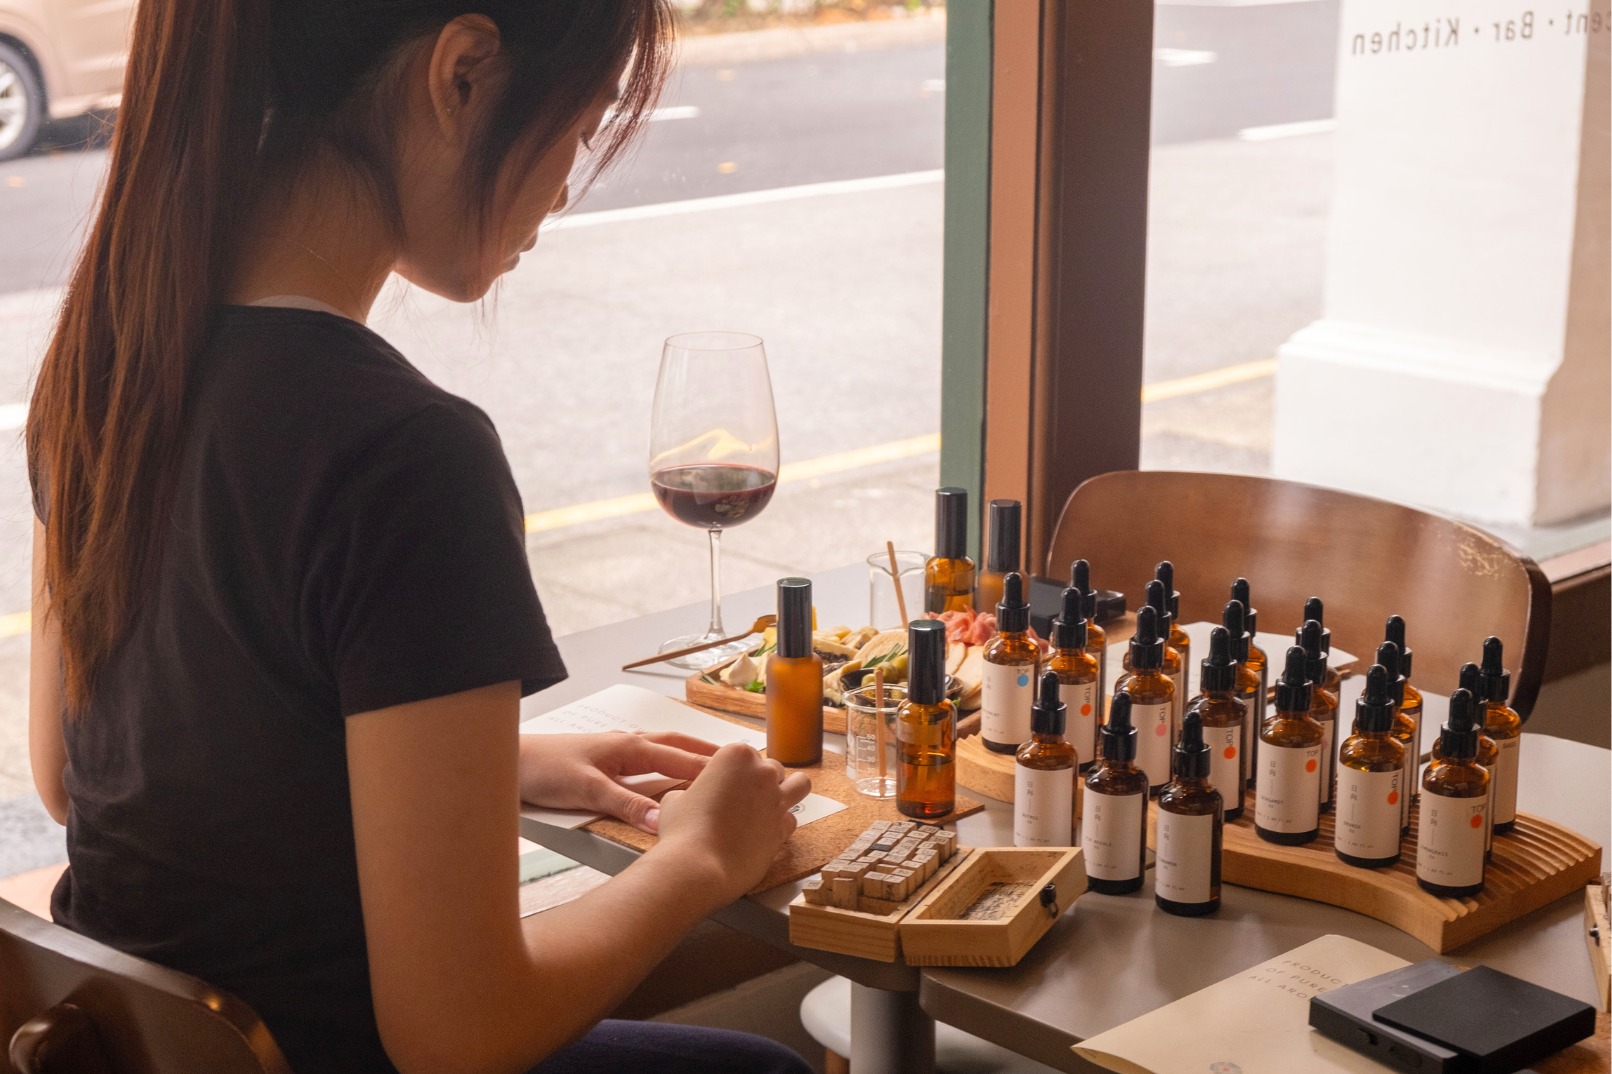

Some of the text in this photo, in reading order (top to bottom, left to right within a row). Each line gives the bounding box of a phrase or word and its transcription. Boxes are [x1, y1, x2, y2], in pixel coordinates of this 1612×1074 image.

[1084, 687, 1092, 704] TOP
[1225, 729, 1234, 746] TOP
[1391, 774, 1399, 791] TOP
[1249, 975, 1310, 1000] ALL ARO
[1265, 967, 1328, 993] OF PURE
